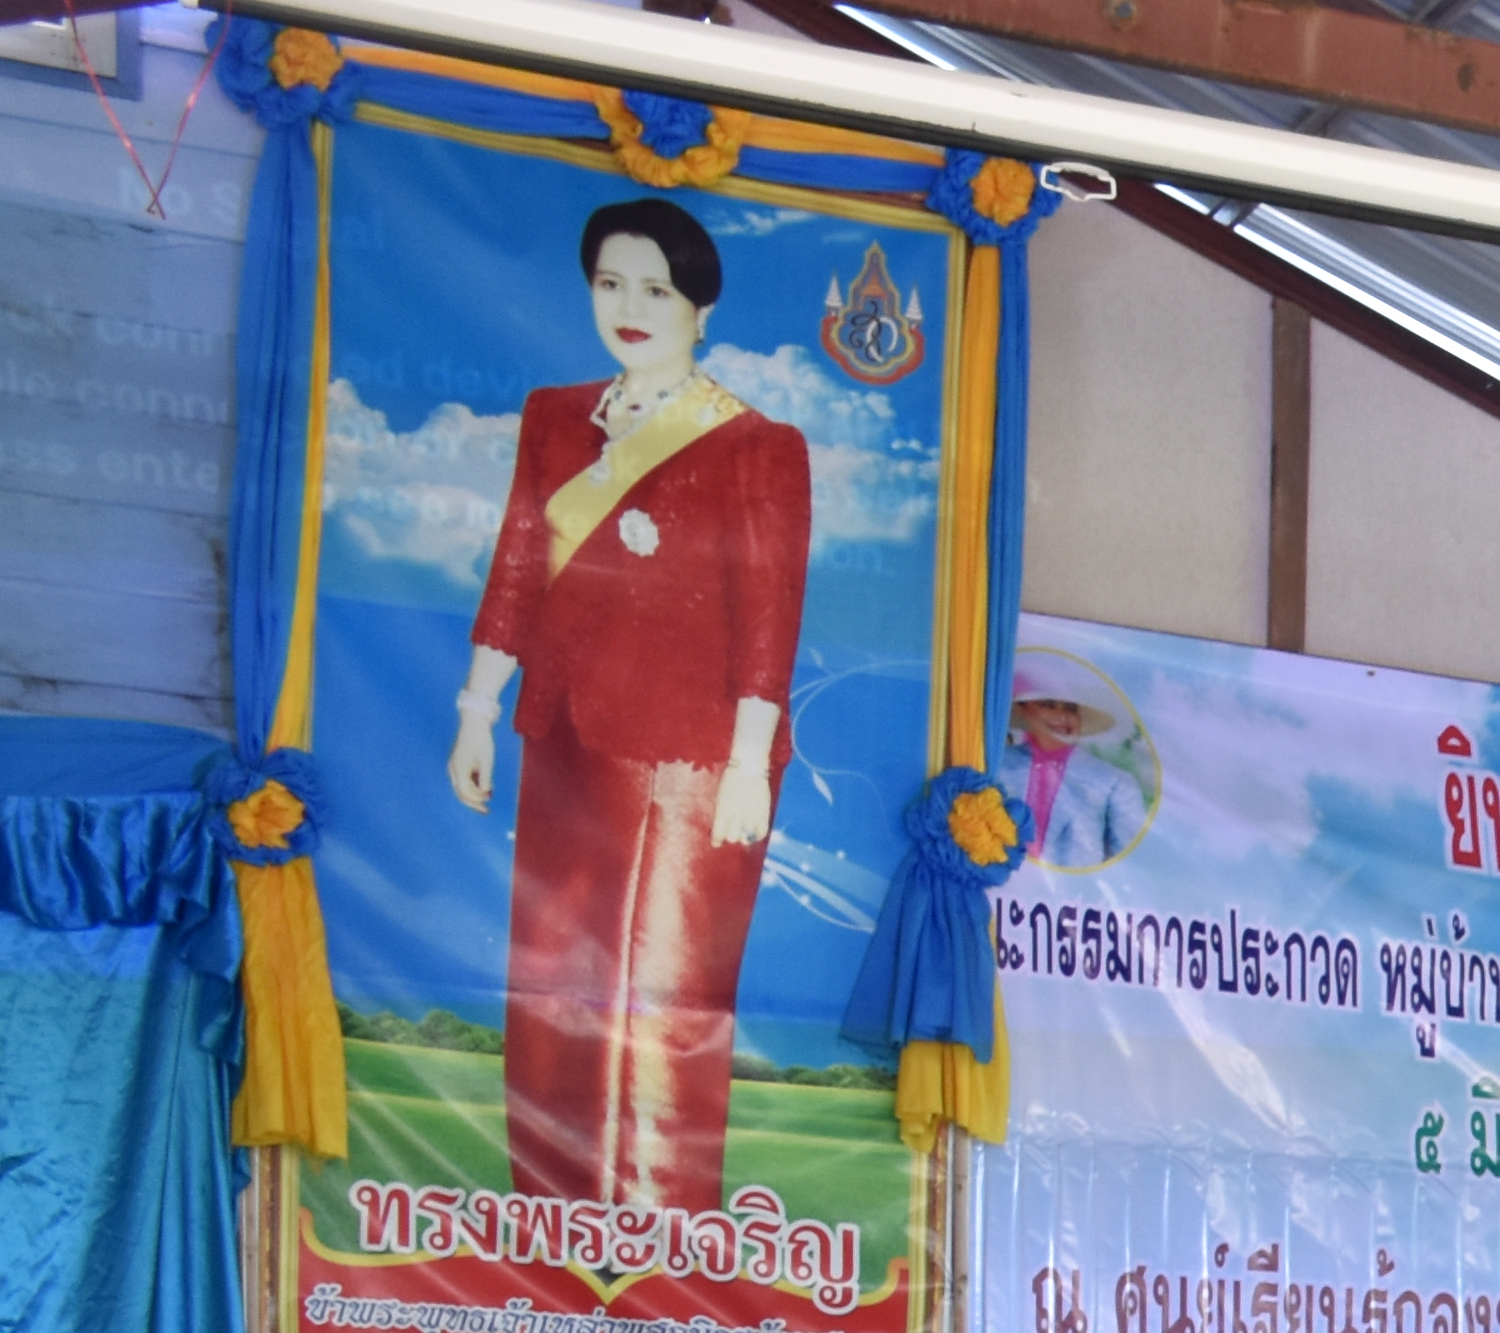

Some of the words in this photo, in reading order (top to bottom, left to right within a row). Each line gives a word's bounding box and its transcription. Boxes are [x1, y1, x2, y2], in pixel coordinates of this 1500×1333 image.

[1415, 1107, 1444, 1174] ๕
[355, 1184, 858, 1310] ทรงพระเจริญ
